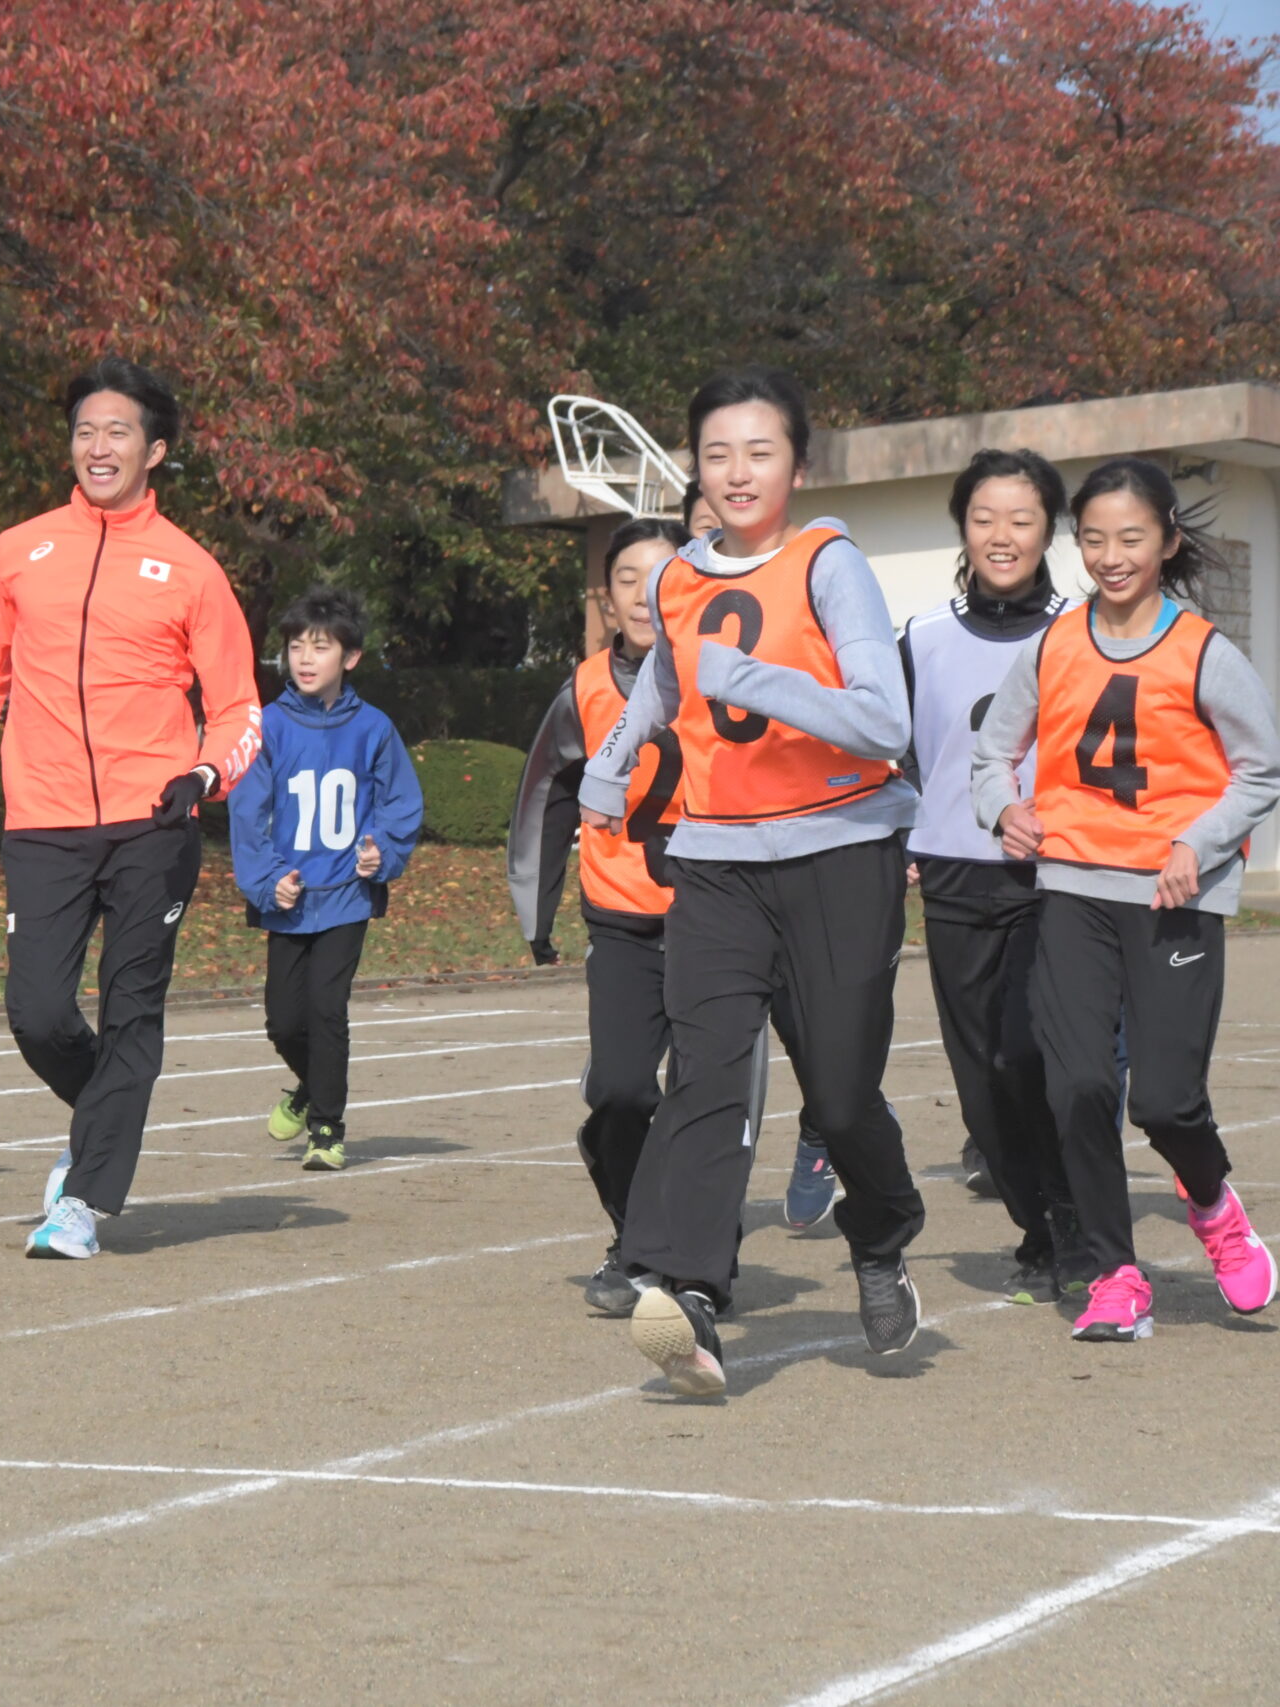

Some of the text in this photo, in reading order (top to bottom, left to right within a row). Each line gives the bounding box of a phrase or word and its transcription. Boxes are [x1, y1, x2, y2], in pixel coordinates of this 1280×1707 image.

[600, 711, 627, 758] OXIC
[1075, 673, 1148, 810] 4
[288, 768, 357, 851] 10
